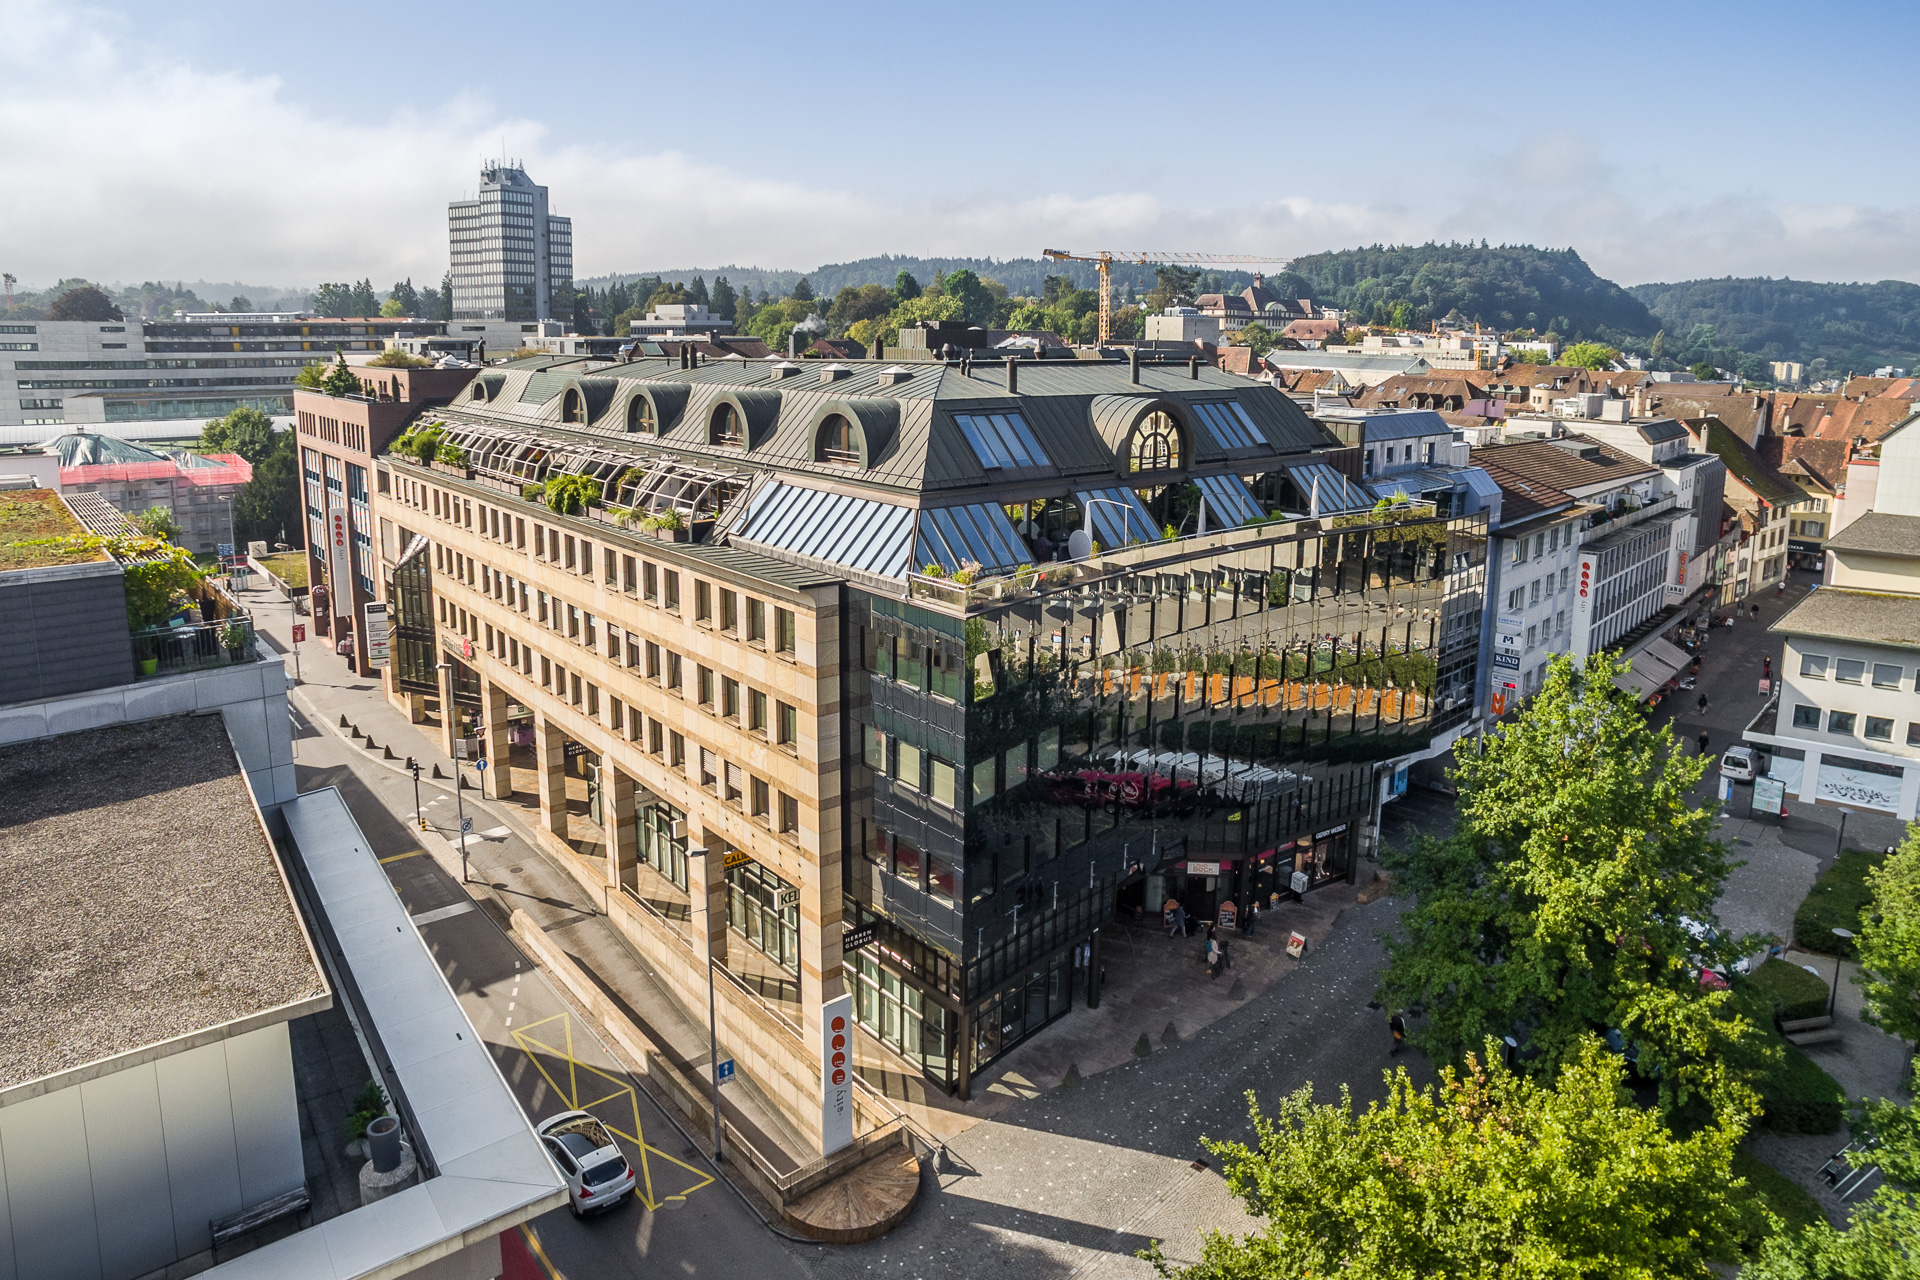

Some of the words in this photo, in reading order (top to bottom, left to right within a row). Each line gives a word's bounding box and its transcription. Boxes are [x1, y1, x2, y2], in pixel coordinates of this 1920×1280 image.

[1495, 655, 1518, 665] KIND
[1331, 824, 1347, 834] WEBER
[845, 929, 872, 943] HERREN
[845, 935, 872, 949] GLOBUS
[834, 1089, 846, 1114] city
